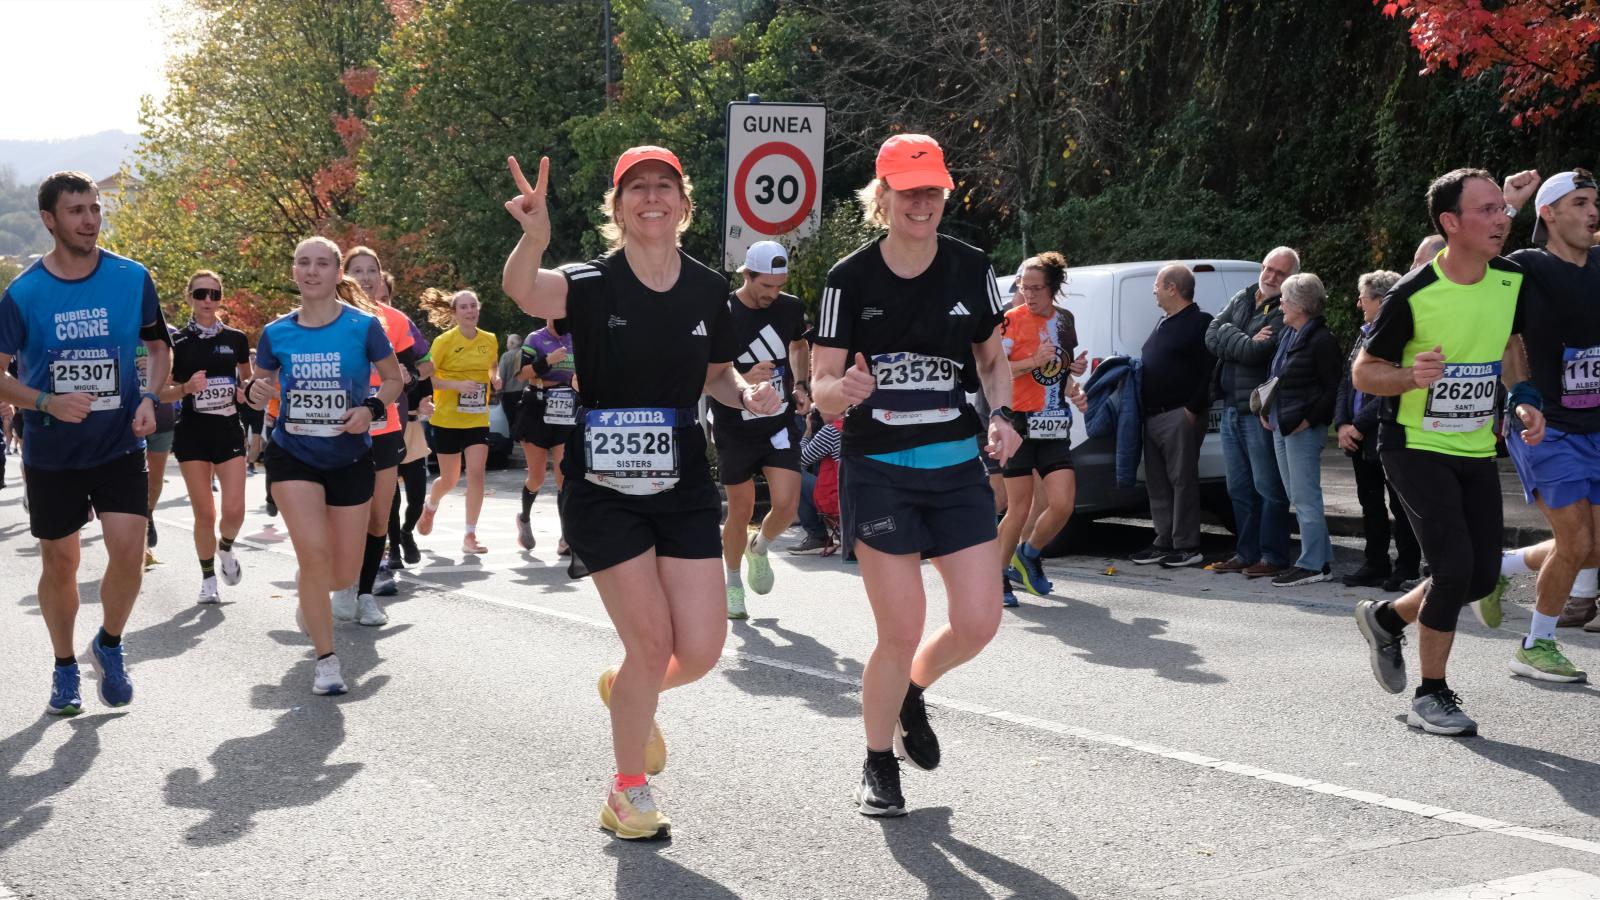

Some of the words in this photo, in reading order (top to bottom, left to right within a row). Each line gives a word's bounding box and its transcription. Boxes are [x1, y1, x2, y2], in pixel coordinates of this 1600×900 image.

[743, 116, 812, 133] GUNEA
[755, 174, 799, 205] 30
[54, 307, 108, 323] RUBIELOS
[55, 319, 110, 341] CORRE
[291, 352, 341, 363] RUBIELOS
[56, 364, 113, 381] 25307
[292, 362, 341, 379] CORRE
[879, 360, 952, 385] 23529
[197, 387, 234, 400] 23928
[1435, 380, 1494, 400] 26200
[292, 394, 345, 409] 25310
[549, 399, 573, 409] 21754
[1031, 419, 1068, 431] 24074
[593, 432, 670, 455] 23528
[616, 460, 652, 468] SISTERS
